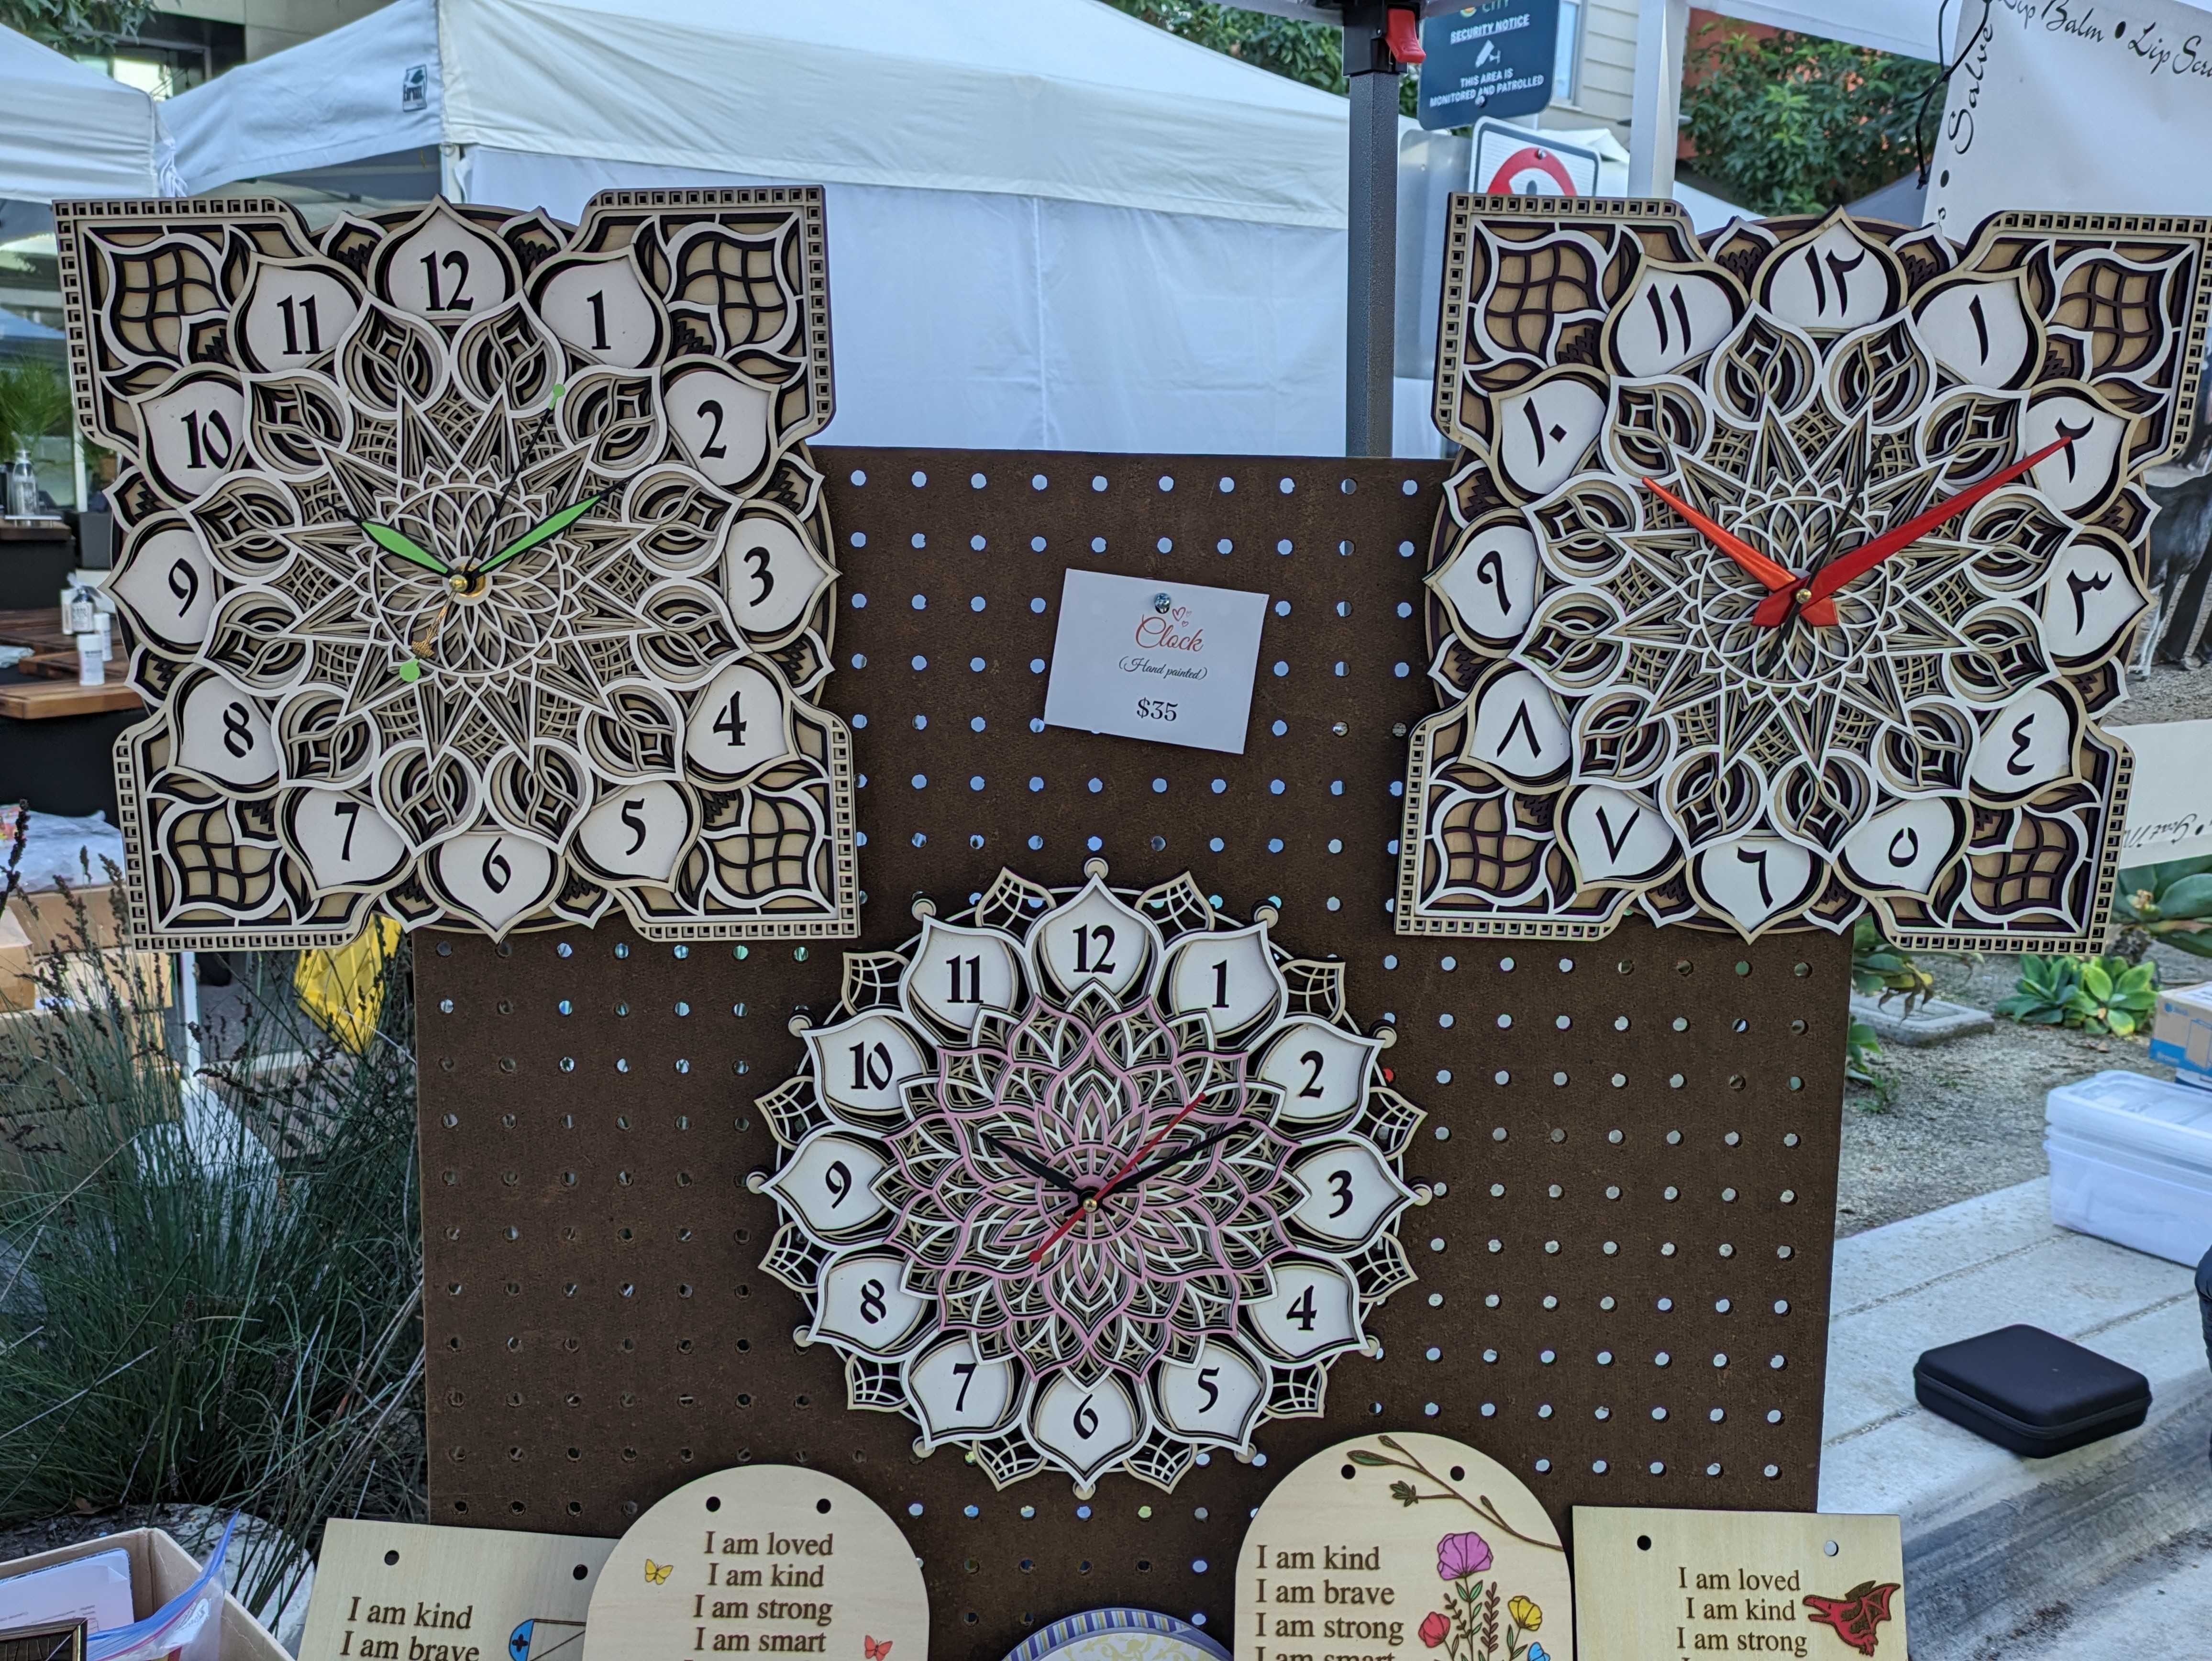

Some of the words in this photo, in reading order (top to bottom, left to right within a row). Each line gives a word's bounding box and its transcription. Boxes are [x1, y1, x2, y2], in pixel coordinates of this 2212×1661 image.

[1450, 23, 1494, 44] SECURITY
[1495, 13, 1530, 33] NOTICE
[2041, 0, 2104, 43] Balm
[2128, 22, 2171, 75] Lip
[1429, 89, 1476, 108] MONITORED
[1478, 84, 1495, 96] AND
[1496, 74, 1544, 94] PATROLLED
[1460, 75, 1479, 89] THIS
[1480, 71, 1503, 85] AREA
[1504, 67, 1514, 79] IS
[1947, 23, 1993, 155] Salve
[420, 250, 474, 312] 12
[276, 294, 325, 355] 11
[586, 289, 612, 351] 1
[180, 409, 233, 470] 10
[696, 399, 728, 460] 2
[167, 557, 199, 619] 9
[743, 546, 774, 608] 3
[1135, 614, 1204, 652] Clock
[1118, 656, 1165, 677] (Hand
[1163, 665, 1207, 680] painted)
[222, 701, 254, 759] 8
[712, 690, 748, 747] 4
[1136, 697, 1178, 721] $35
[334, 801, 362, 862] 7
[620, 797, 647, 856] 5
[482, 836, 512, 895] 6
[1072, 923, 1117, 975] 12
[945, 954, 984, 1004] 11
[1211, 959, 1230, 1008] 1
[849, 1041, 894, 1091] 10
[1297, 1050, 1325, 1099] 2
[825, 1160, 852, 1210] 9
[1327, 1169, 1354, 1219] 3
[860, 1278, 887, 1325] 8
[1285, 1284, 1318, 1331] 4
[952, 1362, 978, 1413] 7
[1197, 1366, 1220, 1414] 5
[1073, 1393, 1099, 1440] 6
[703, 1530, 716, 1555] I
[721, 1537, 759, 1555] am
[766, 1531, 834, 1557] loved
[1256, 1544, 1268, 1569] I
[1276, 1551, 1316, 1570] am
[1323, 1544, 1381, 1572] kind
[707, 1562, 720, 1586] I
[725, 1569, 763, 1587] am
[770, 1563, 825, 1588] kind
[1255, 1578, 1268, 1603] I
[1275, 1585, 1316, 1604] am
[1323, 1578, 1395, 1606] brave
[1678, 1566, 1688, 1589] I
[1696, 1573, 1731, 1590] am
[1737, 1567, 1802, 1592] loved
[347, 1596, 363, 1622] I
[366, 1605, 406, 1626] am
[413, 1601, 474, 1630] kind
[692, 1594, 706, 1618] I
[711, 1601, 749, 1619] am
[756, 1598, 834, 1628] strong
[1255, 1612, 1267, 1637] I
[1275, 1619, 1316, 1638] am
[1323, 1617, 1405, 1647] strong
[1685, 1596, 1696, 1619] I
[1703, 1603, 1739, 1620] am
[1745, 1597, 1797, 1622] kind
[339, 1630, 355, 1657] I
[359, 1639, 399, 1660] am
[408, 1635, 480, 1661] brave
[693, 1626, 707, 1651] I
[712, 1633, 751, 1652] am
[758, 1632, 827, 1653] smart
[1676, 1626, 1687, 1650] I
[1694, 1633, 1730, 1651] am
[1737, 1631, 1808, 1659] strong
